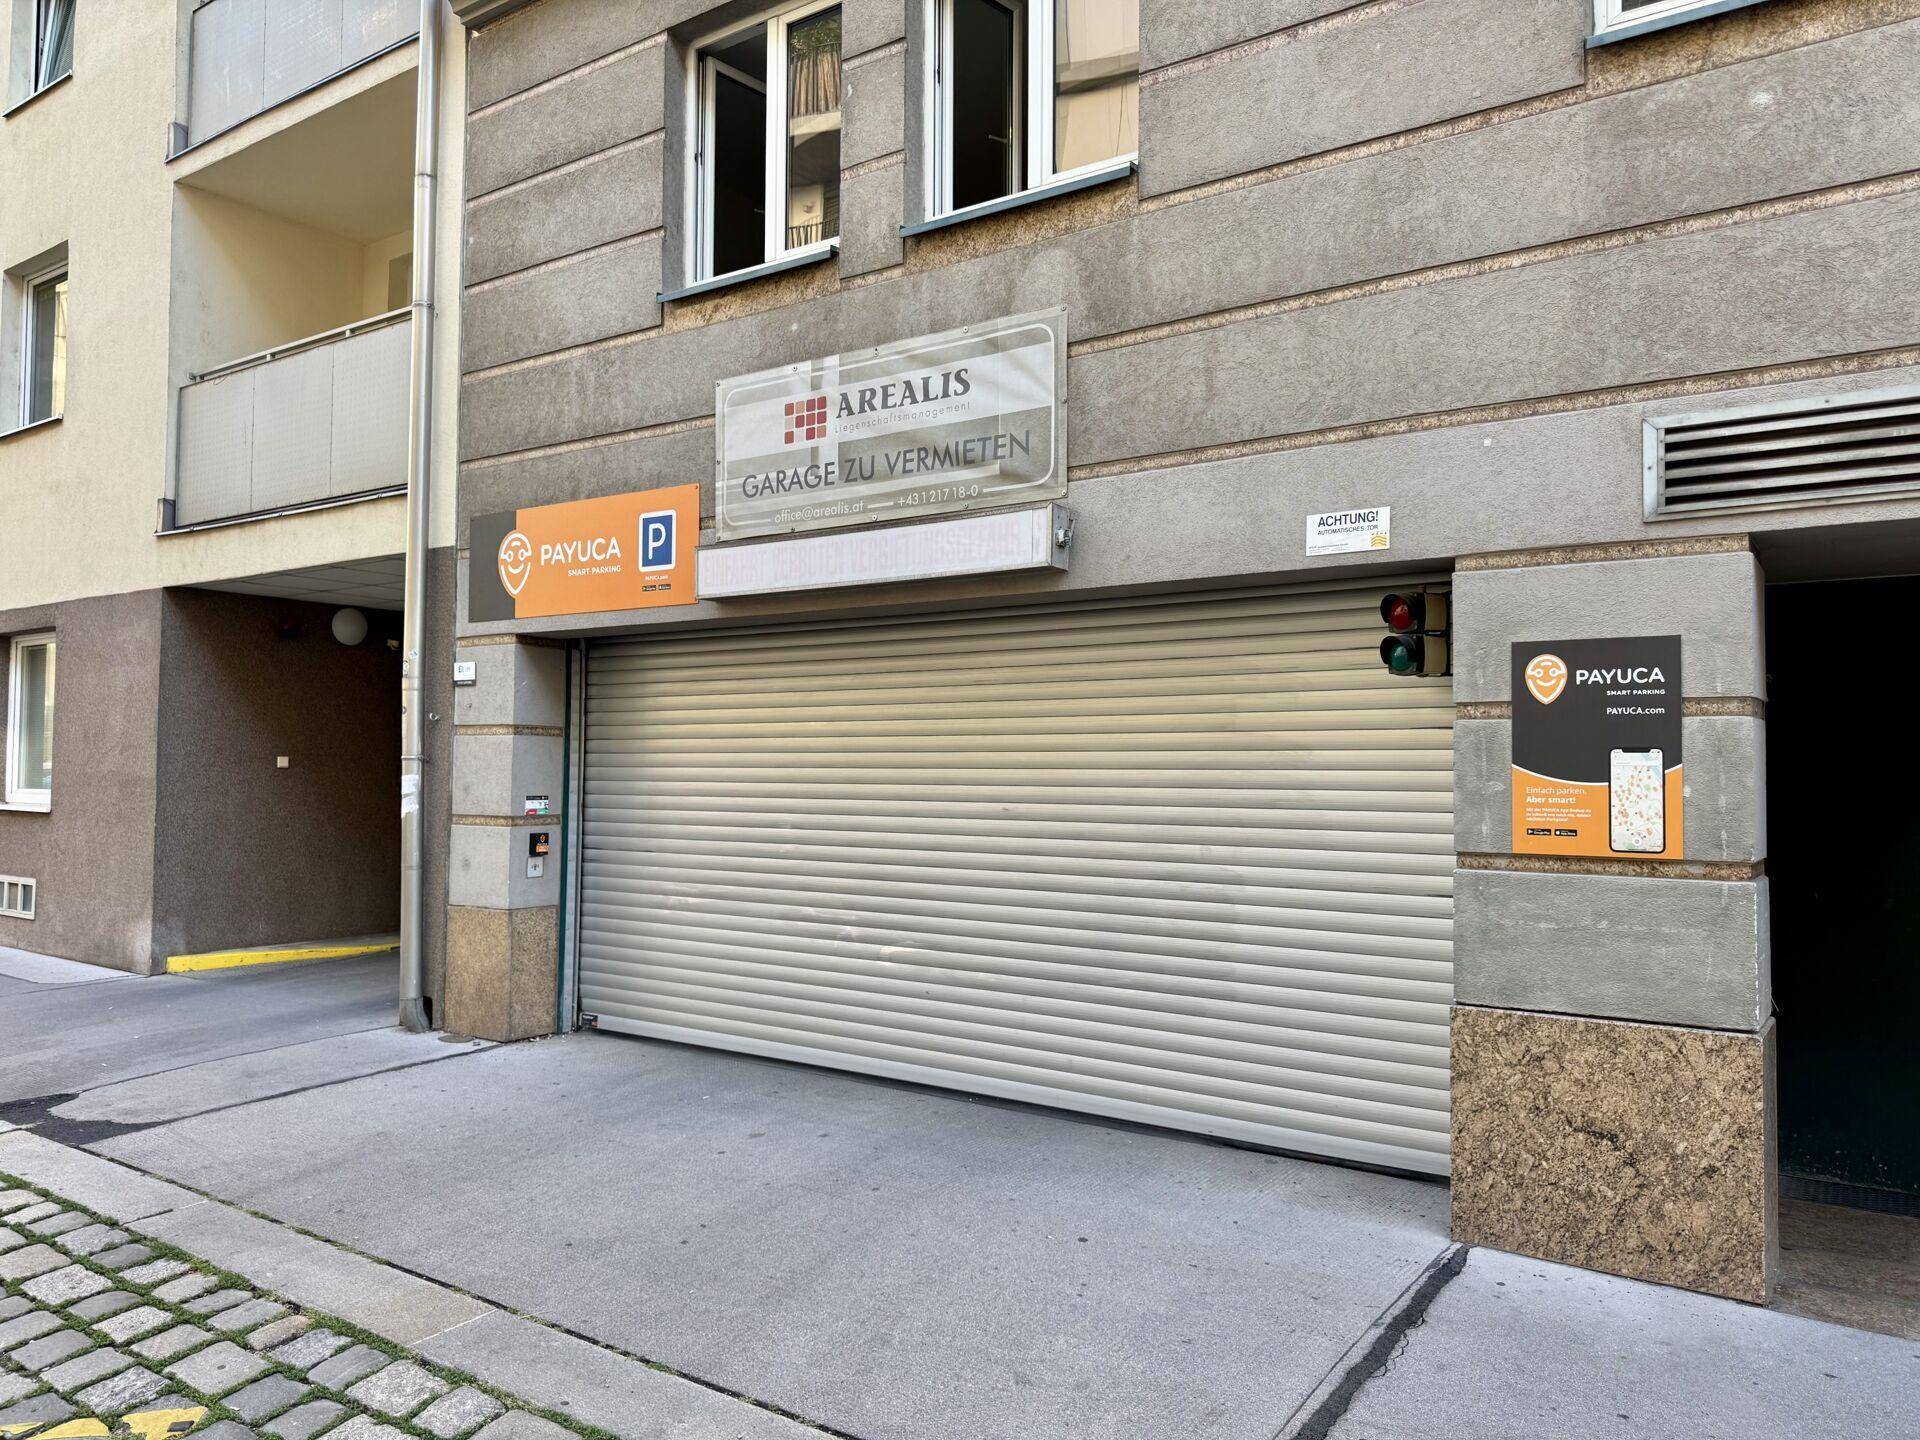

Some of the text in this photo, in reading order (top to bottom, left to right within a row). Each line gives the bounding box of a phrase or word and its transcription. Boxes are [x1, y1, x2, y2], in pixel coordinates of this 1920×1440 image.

[836, 368, 971, 418] AREALIS
[835, 401, 971, 433] Liegenschaftsmanagement
[743, 430, 1031, 499] GARAGE ZU VERMIETEN
[774, 500, 865, 524] office@arealis.at
[1318, 511, 1379, 527] ACHTUNG!
[1317, 526, 1365, 535] AUTOMATISCHES
[541, 523, 666, 566] PAYUCA P
[568, 564, 622, 577] SMART PARKING
[1575, 667, 1665, 685] PAYUCA
[1606, 706, 1665, 715] PAYUCA.com
[1526, 786, 1588, 796] Einfach parken.
[1548, 796, 1577, 804] smart!
